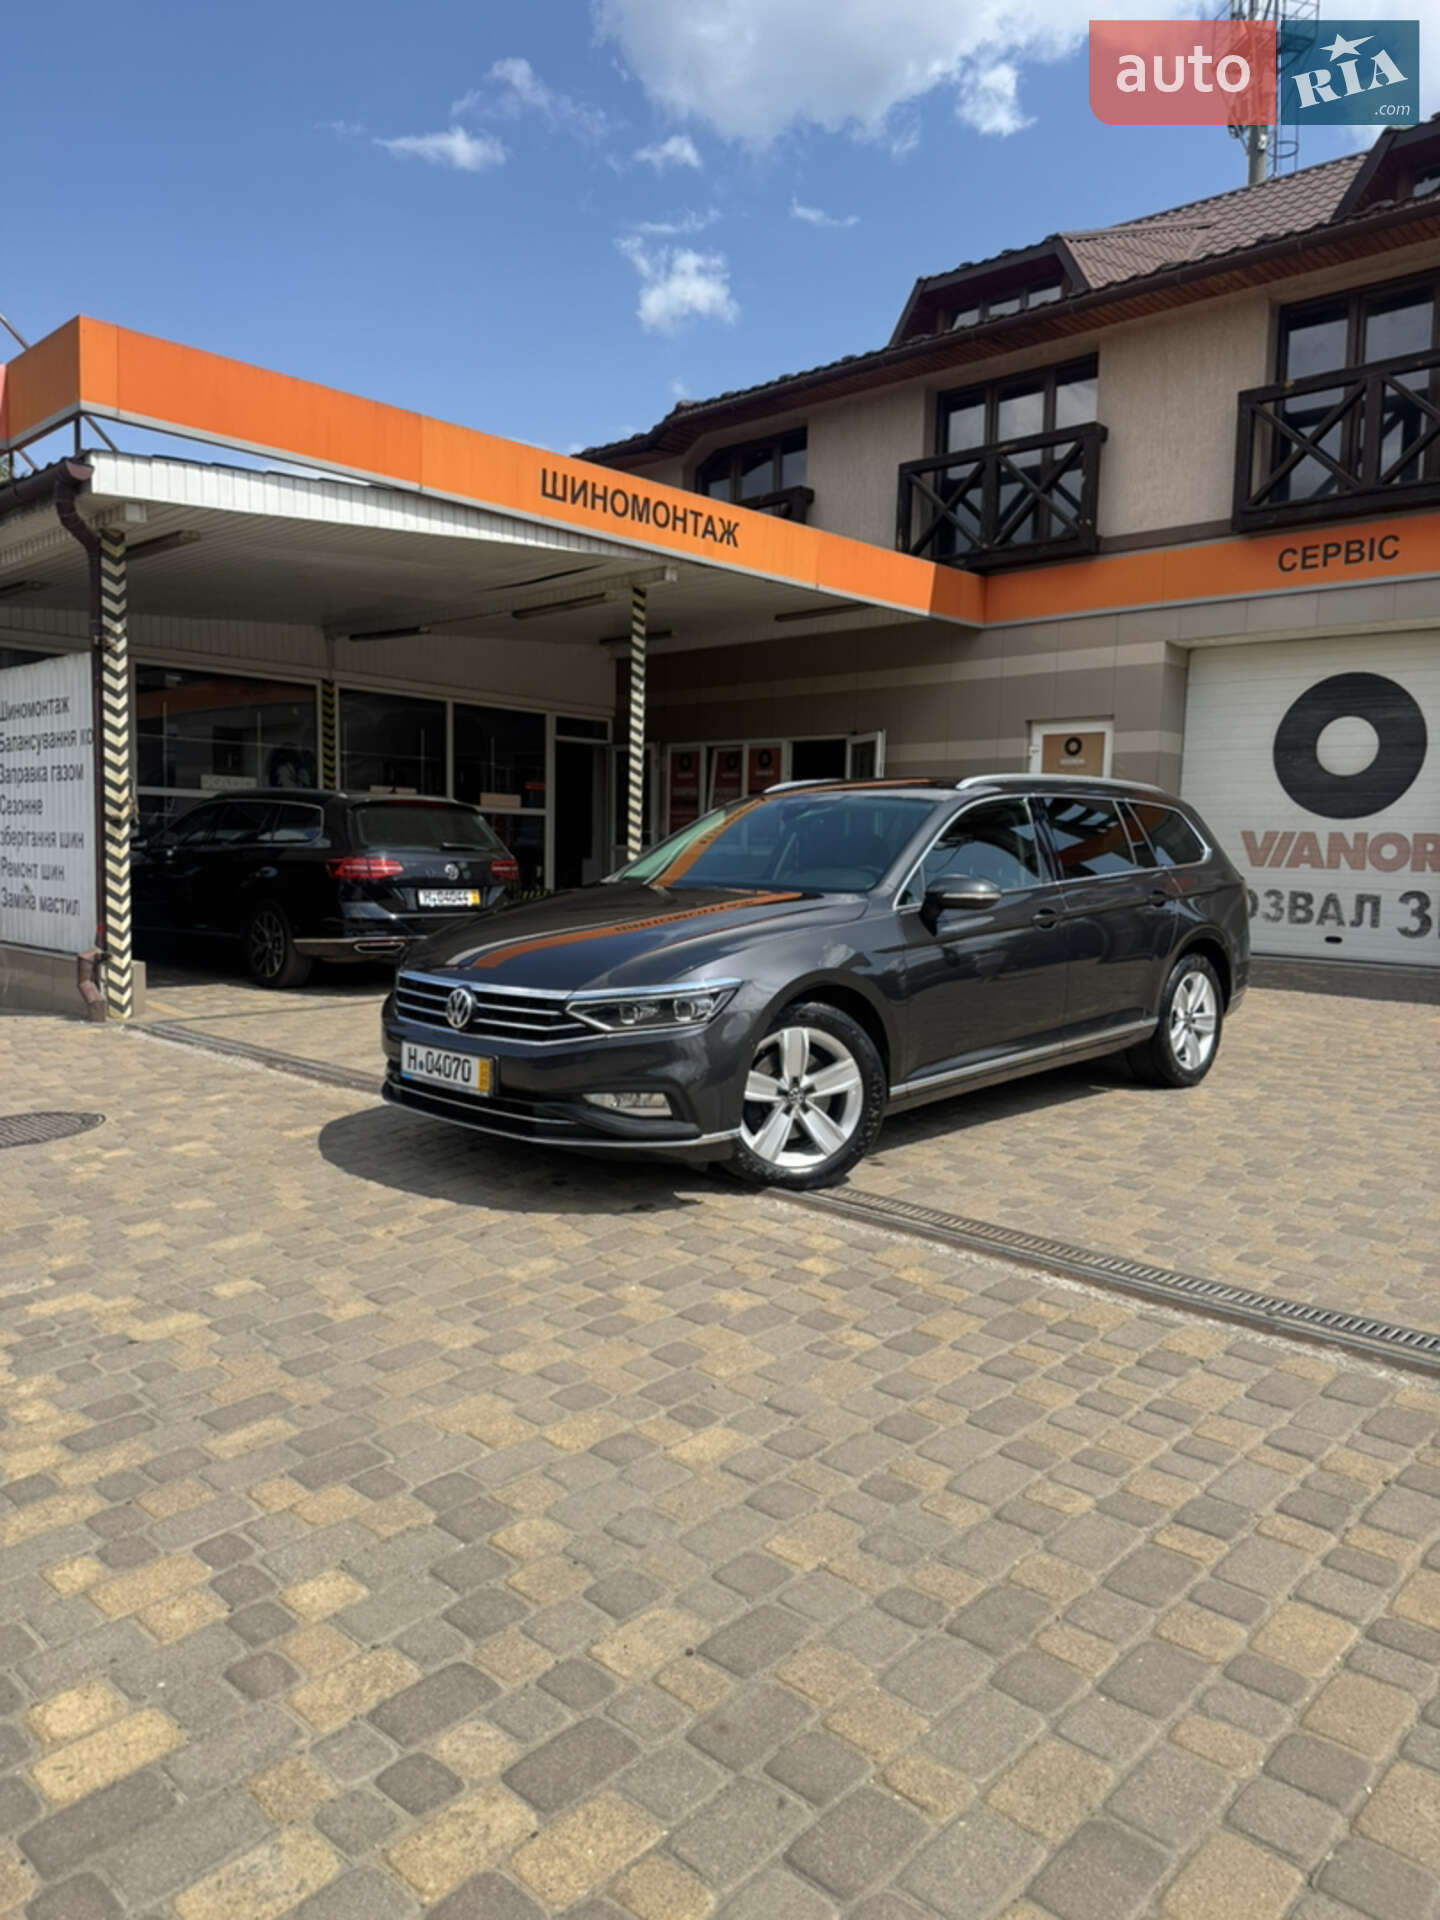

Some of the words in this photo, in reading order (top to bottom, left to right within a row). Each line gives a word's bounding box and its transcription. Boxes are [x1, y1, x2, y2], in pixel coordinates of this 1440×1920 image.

[541, 468, 740, 548] ШИНОМОНТАЖ
[1277, 534, 1400, 573] СЕРВІС
[50, 763, 84, 782] газом
[59, 831, 84, 849] шин
[1240, 831, 1440, 873] VIANOR
[41, 864, 64, 881] шин
